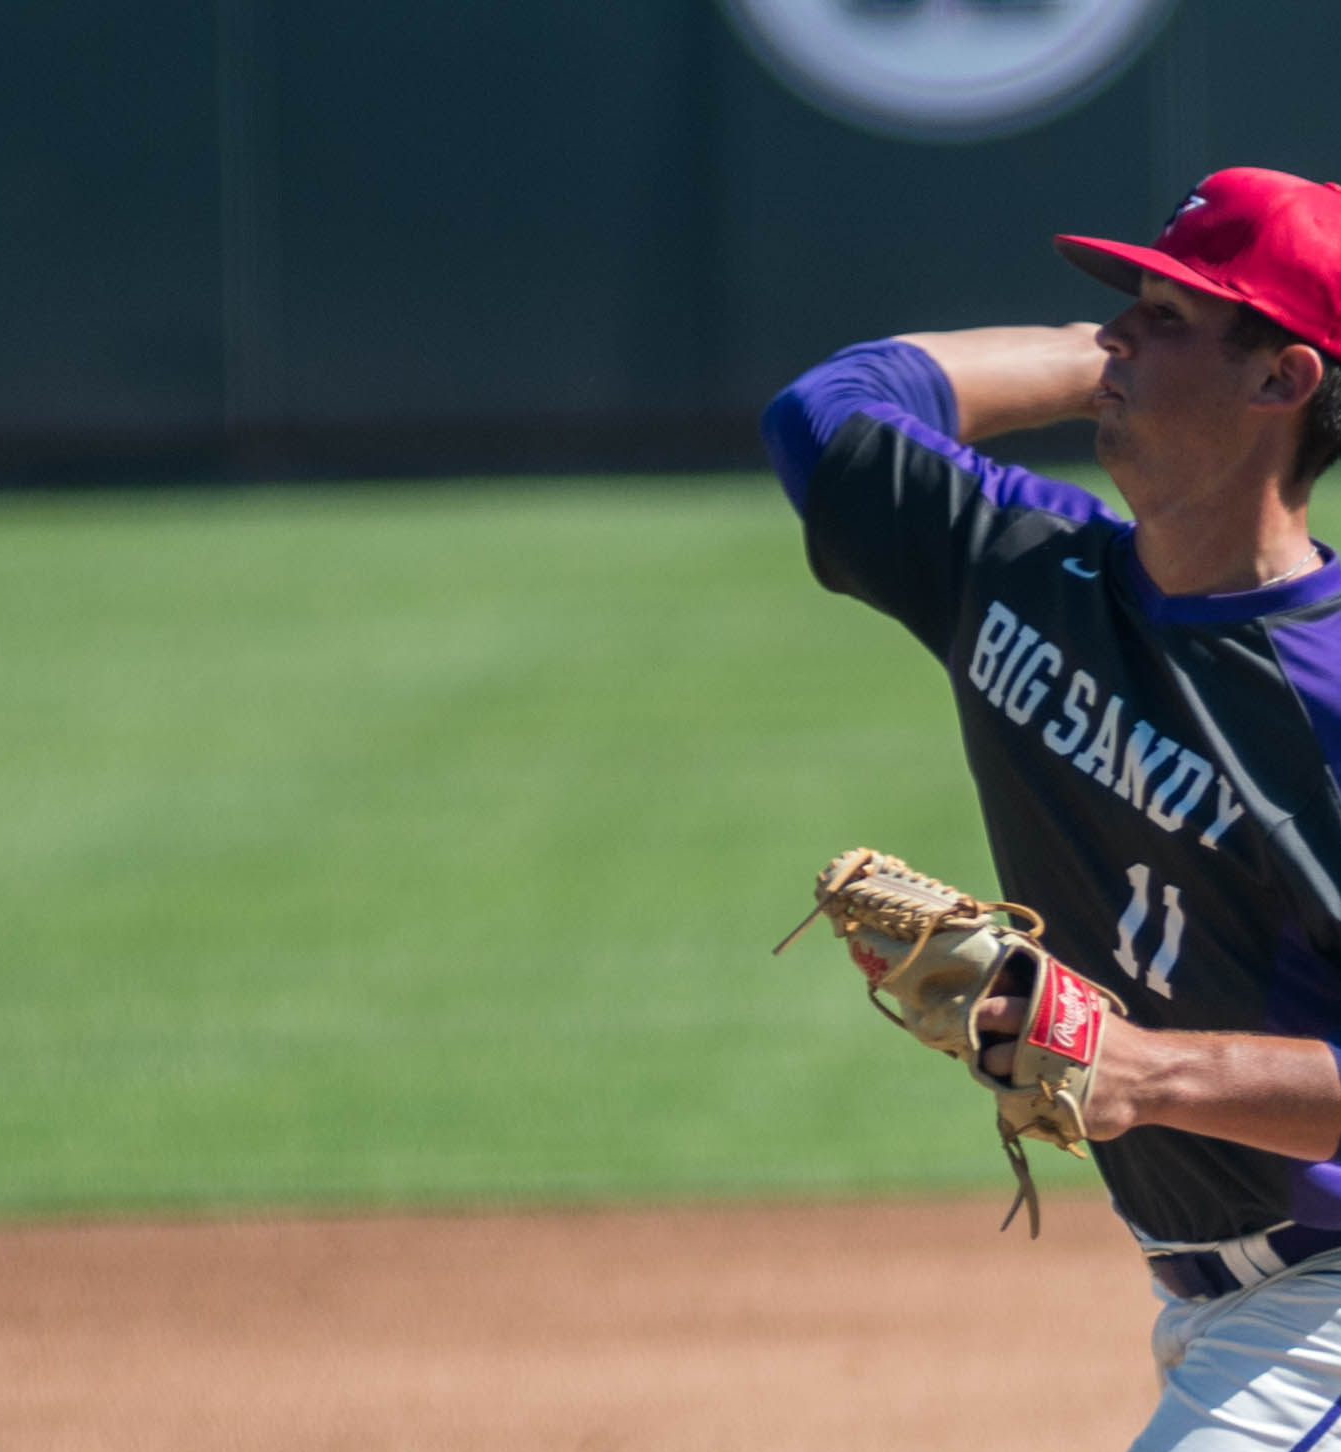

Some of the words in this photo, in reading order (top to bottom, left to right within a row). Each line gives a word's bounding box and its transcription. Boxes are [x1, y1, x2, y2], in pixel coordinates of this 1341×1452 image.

[968, 600, 1063, 726] BIG
[1042, 668, 1245, 851] SANDY
[1112, 862, 1185, 999] 11
